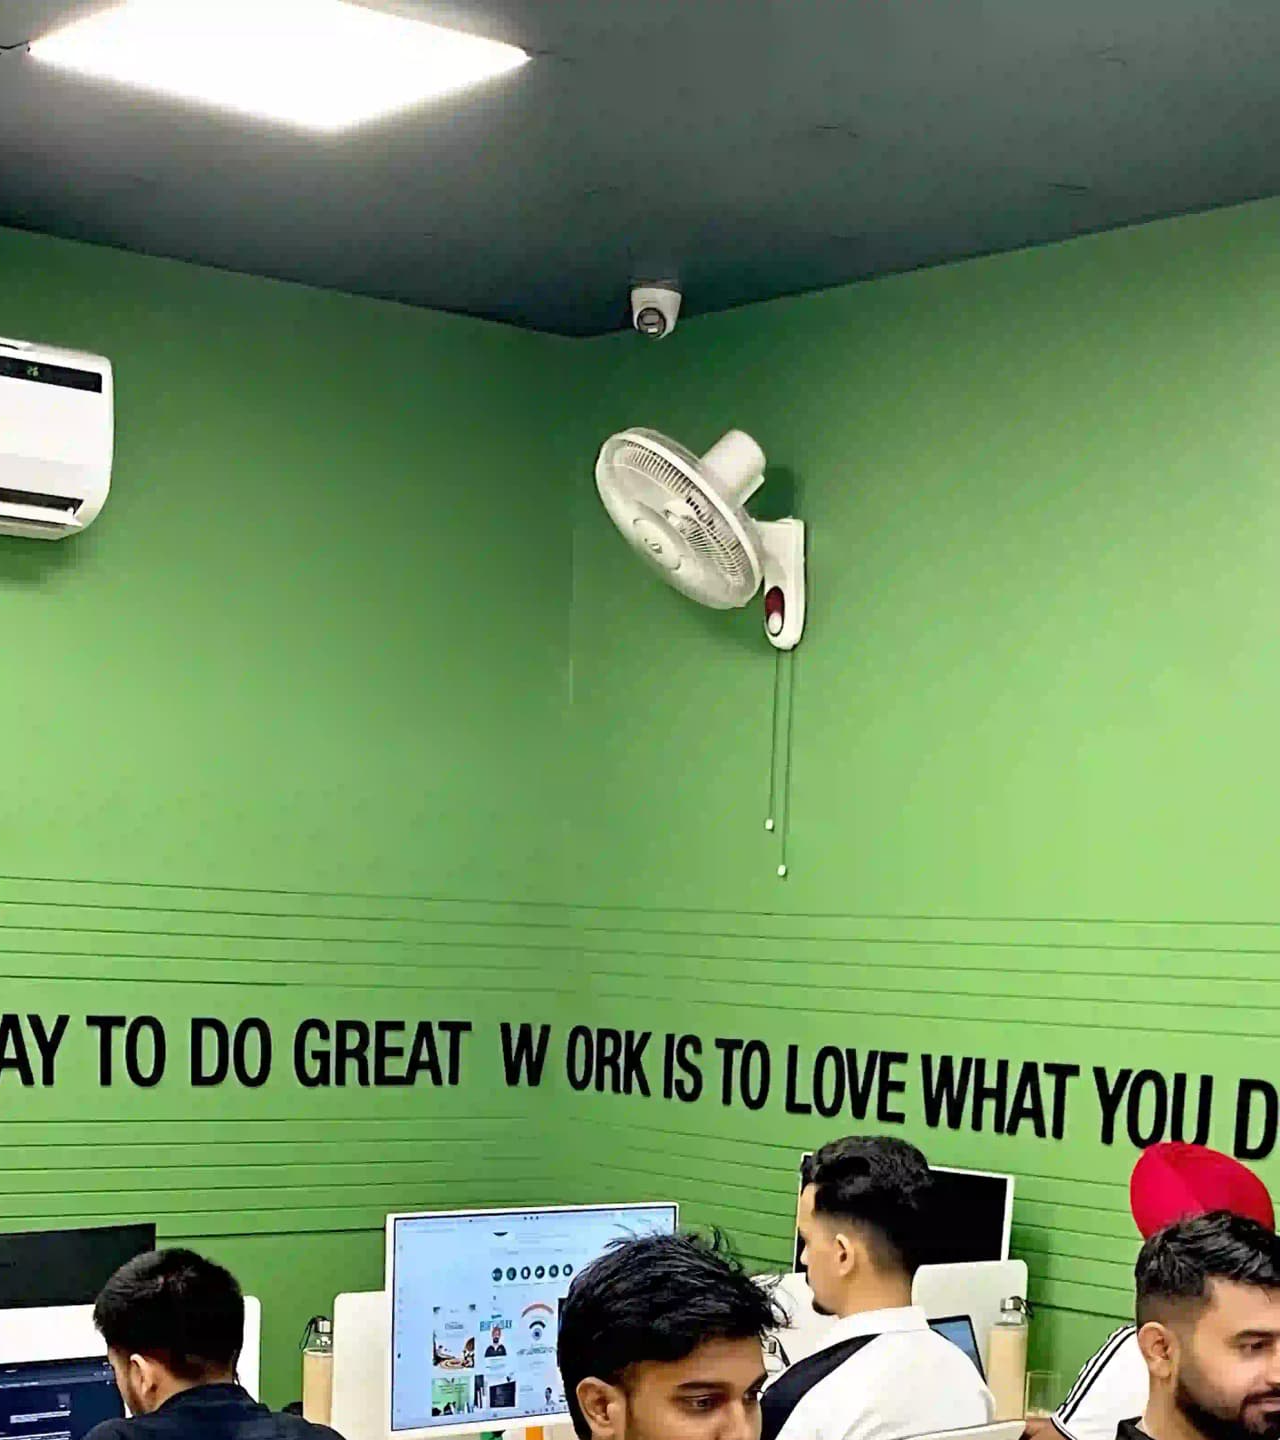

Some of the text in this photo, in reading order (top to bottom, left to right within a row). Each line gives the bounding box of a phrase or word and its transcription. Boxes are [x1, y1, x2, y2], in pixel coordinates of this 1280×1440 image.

[86, 1015, 166, 1087] TO
[190, 1017, 272, 1087] DO
[294, 1018, 473, 1088] GREAT
[663, 1033, 703, 1103] IS
[714, 1038, 771, 1110] TO
[785, 1044, 909, 1124] LOVE
[920, 1054, 1081, 1140] WHAT
[1091, 1066, 1215, 1150] YOU
